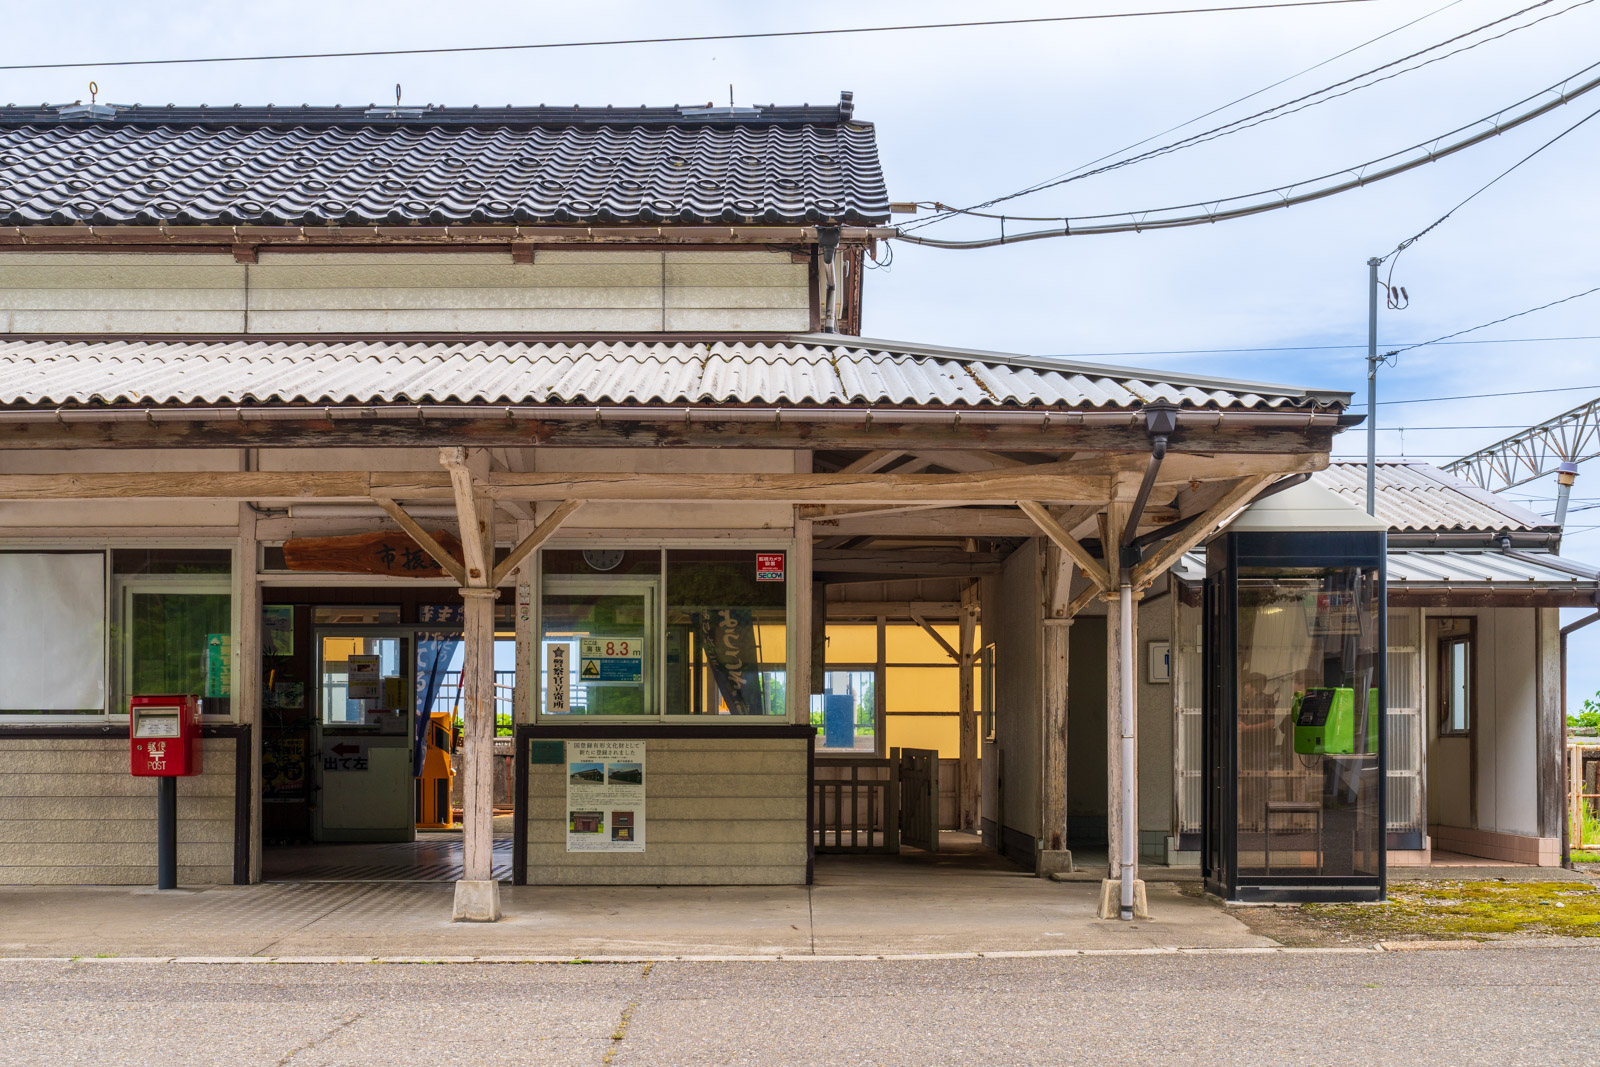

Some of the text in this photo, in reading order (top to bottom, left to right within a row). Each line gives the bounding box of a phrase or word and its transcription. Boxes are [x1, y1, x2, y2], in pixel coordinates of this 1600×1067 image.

[376, 543, 443, 571] 市振
[606, 641, 629, 656] 8.3
[553, 658, 564, 709] 警察官立寄所
[147, 741, 167, 752] 郵便
[579, 749, 636, 757] 新たに登録されました
[147, 761, 167, 771] POST
[324, 757, 369, 771] 出て左
